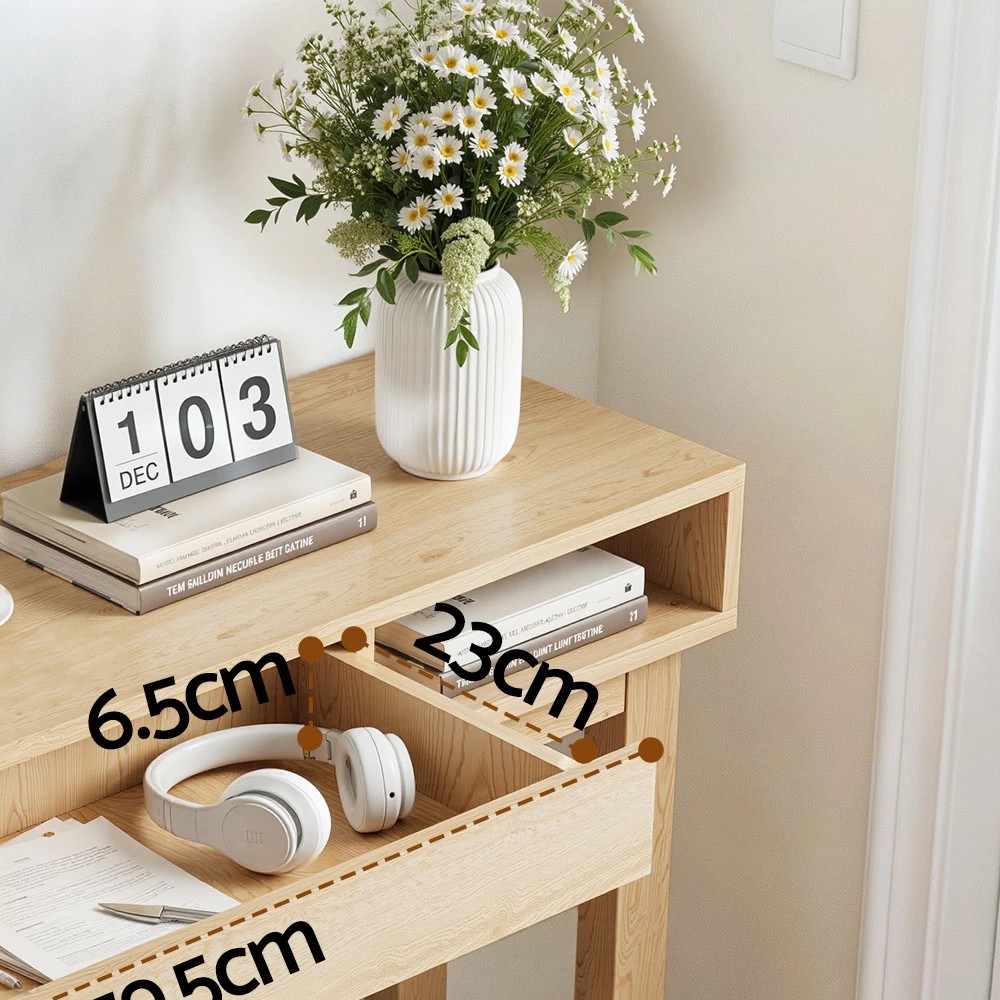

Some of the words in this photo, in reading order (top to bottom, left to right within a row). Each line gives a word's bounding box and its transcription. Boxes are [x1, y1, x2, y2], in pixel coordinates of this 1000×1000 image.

[117, 411, 141, 455] 1
[178, 395, 215, 460] 0
[239, 375, 277, 441] 3
[119, 462, 160, 490] DEC
